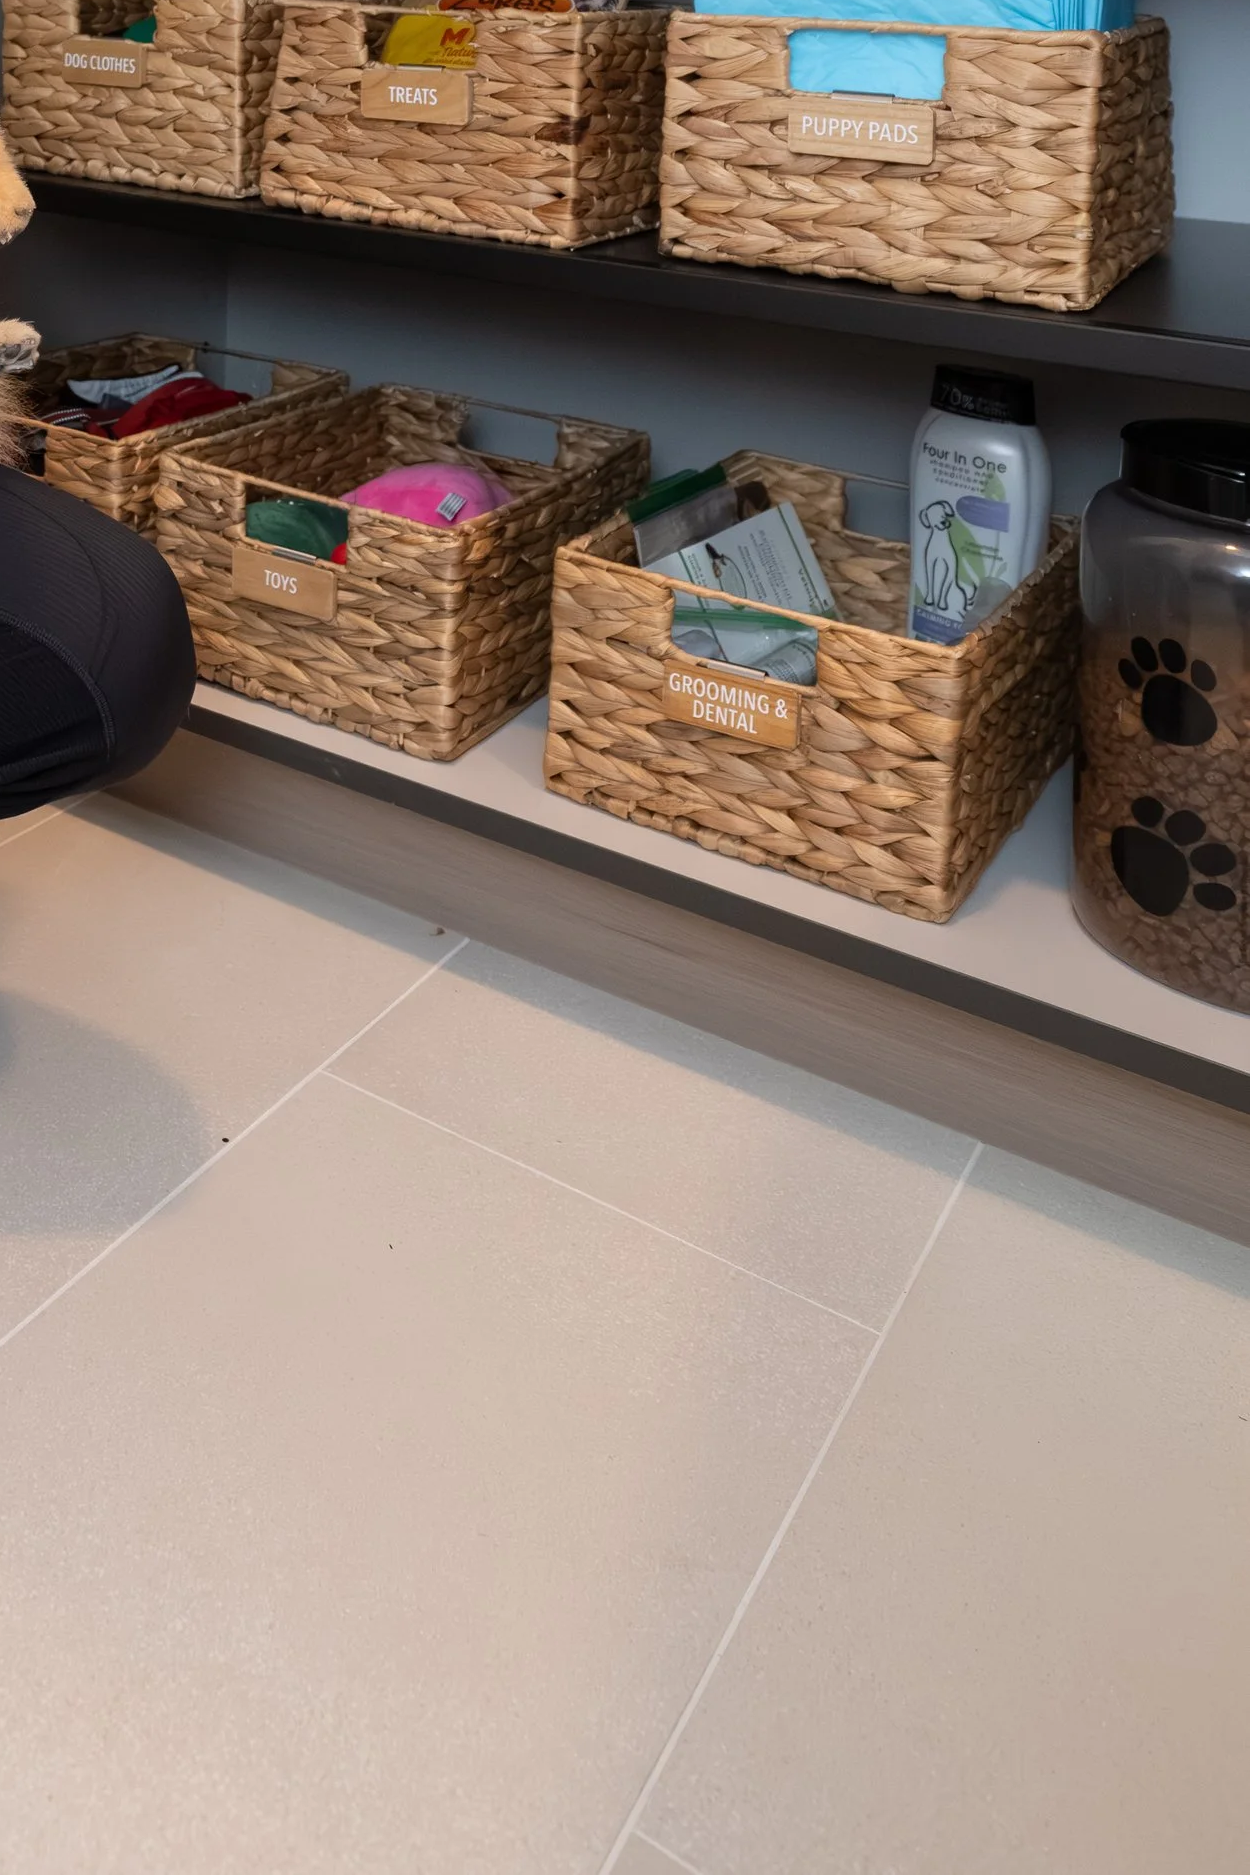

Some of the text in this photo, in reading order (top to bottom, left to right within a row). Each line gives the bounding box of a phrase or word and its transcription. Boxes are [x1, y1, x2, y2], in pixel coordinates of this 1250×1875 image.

[64, 53, 136, 74] DOG CLOTHES
[388, 86, 438, 105] TREATS
[802, 115, 918, 144] PUPPY PADS
[923, 442, 1007, 473] Four In One
[264, 569, 298, 594] TOYS
[669, 672, 789, 720] GROOMING &
[693, 700, 758, 735] DENTAL
